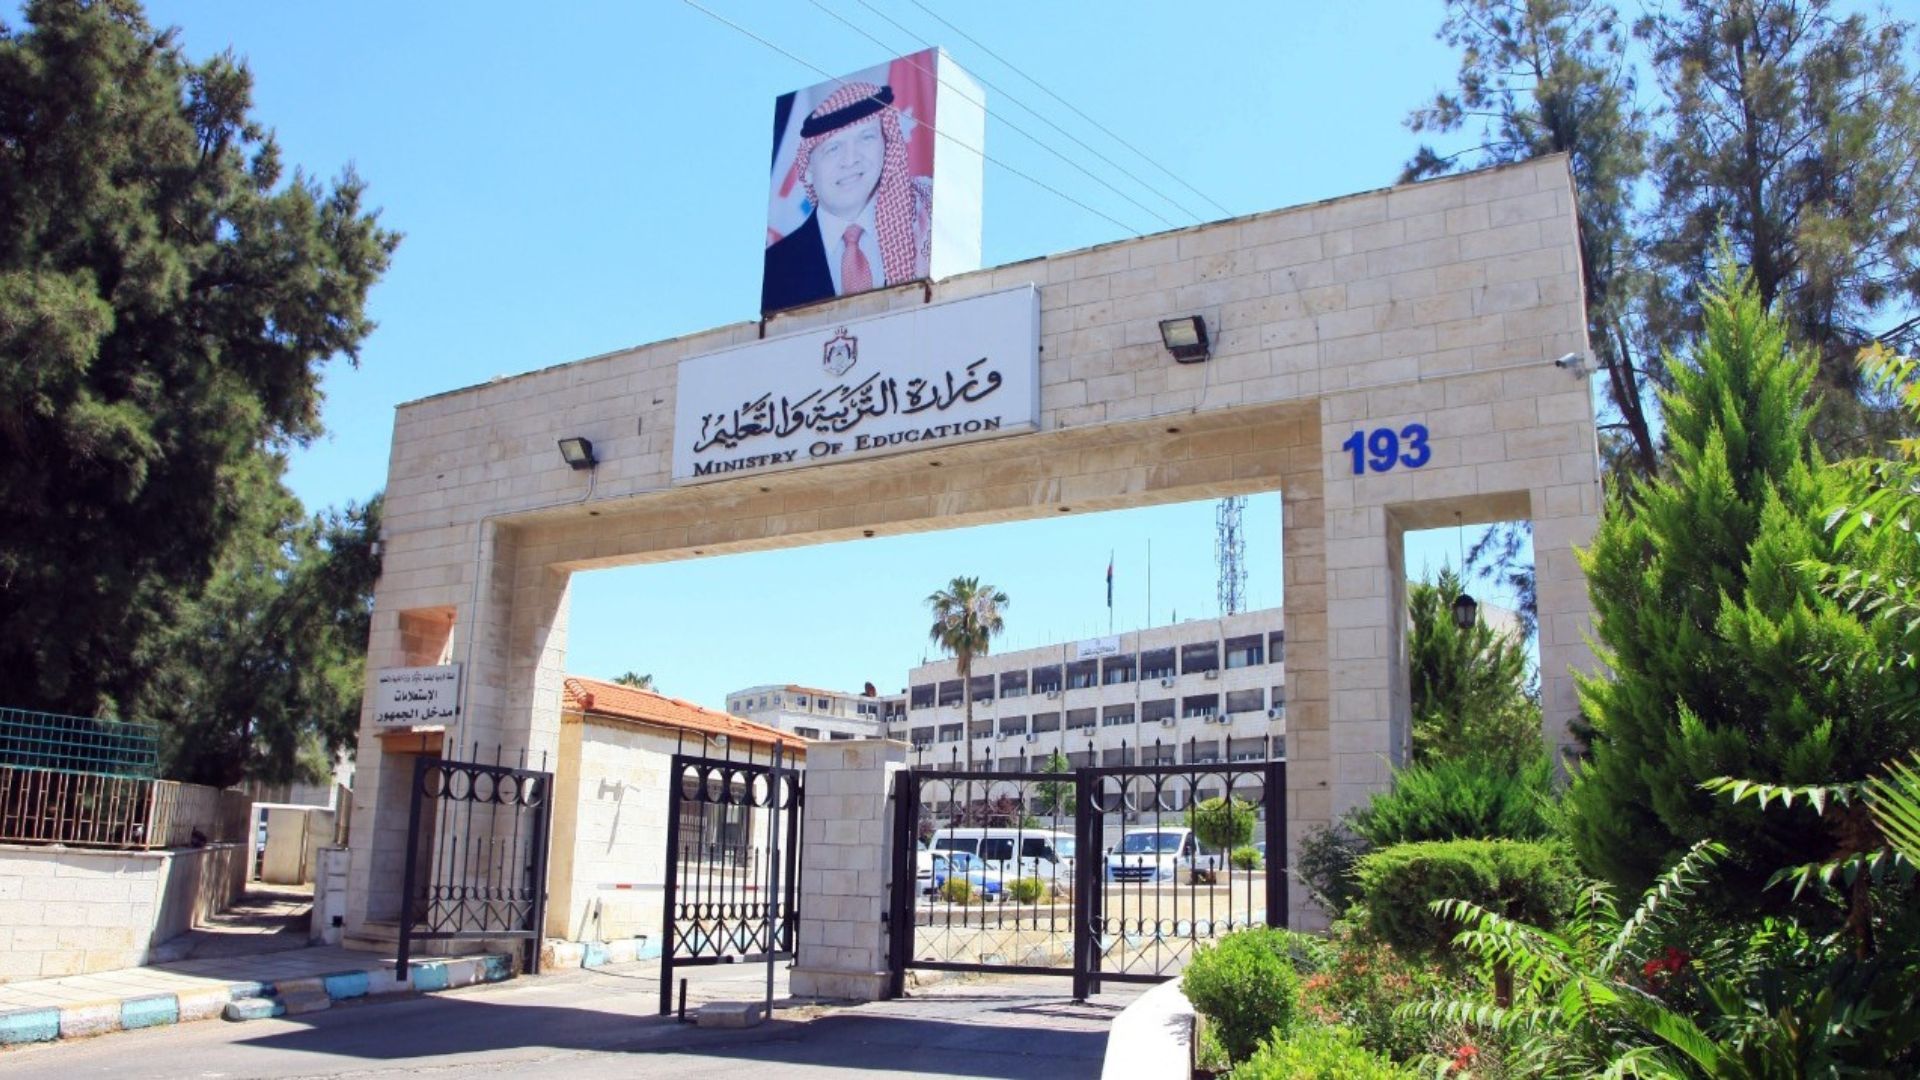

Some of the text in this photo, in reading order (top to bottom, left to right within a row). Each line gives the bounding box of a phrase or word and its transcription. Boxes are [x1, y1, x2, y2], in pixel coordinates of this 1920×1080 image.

[693, 357, 1003, 453] وزارة التربية والتعليم
[1343, 423, 1431, 475] 193
[376, 706, 453, 721] مدخل الجمهور
